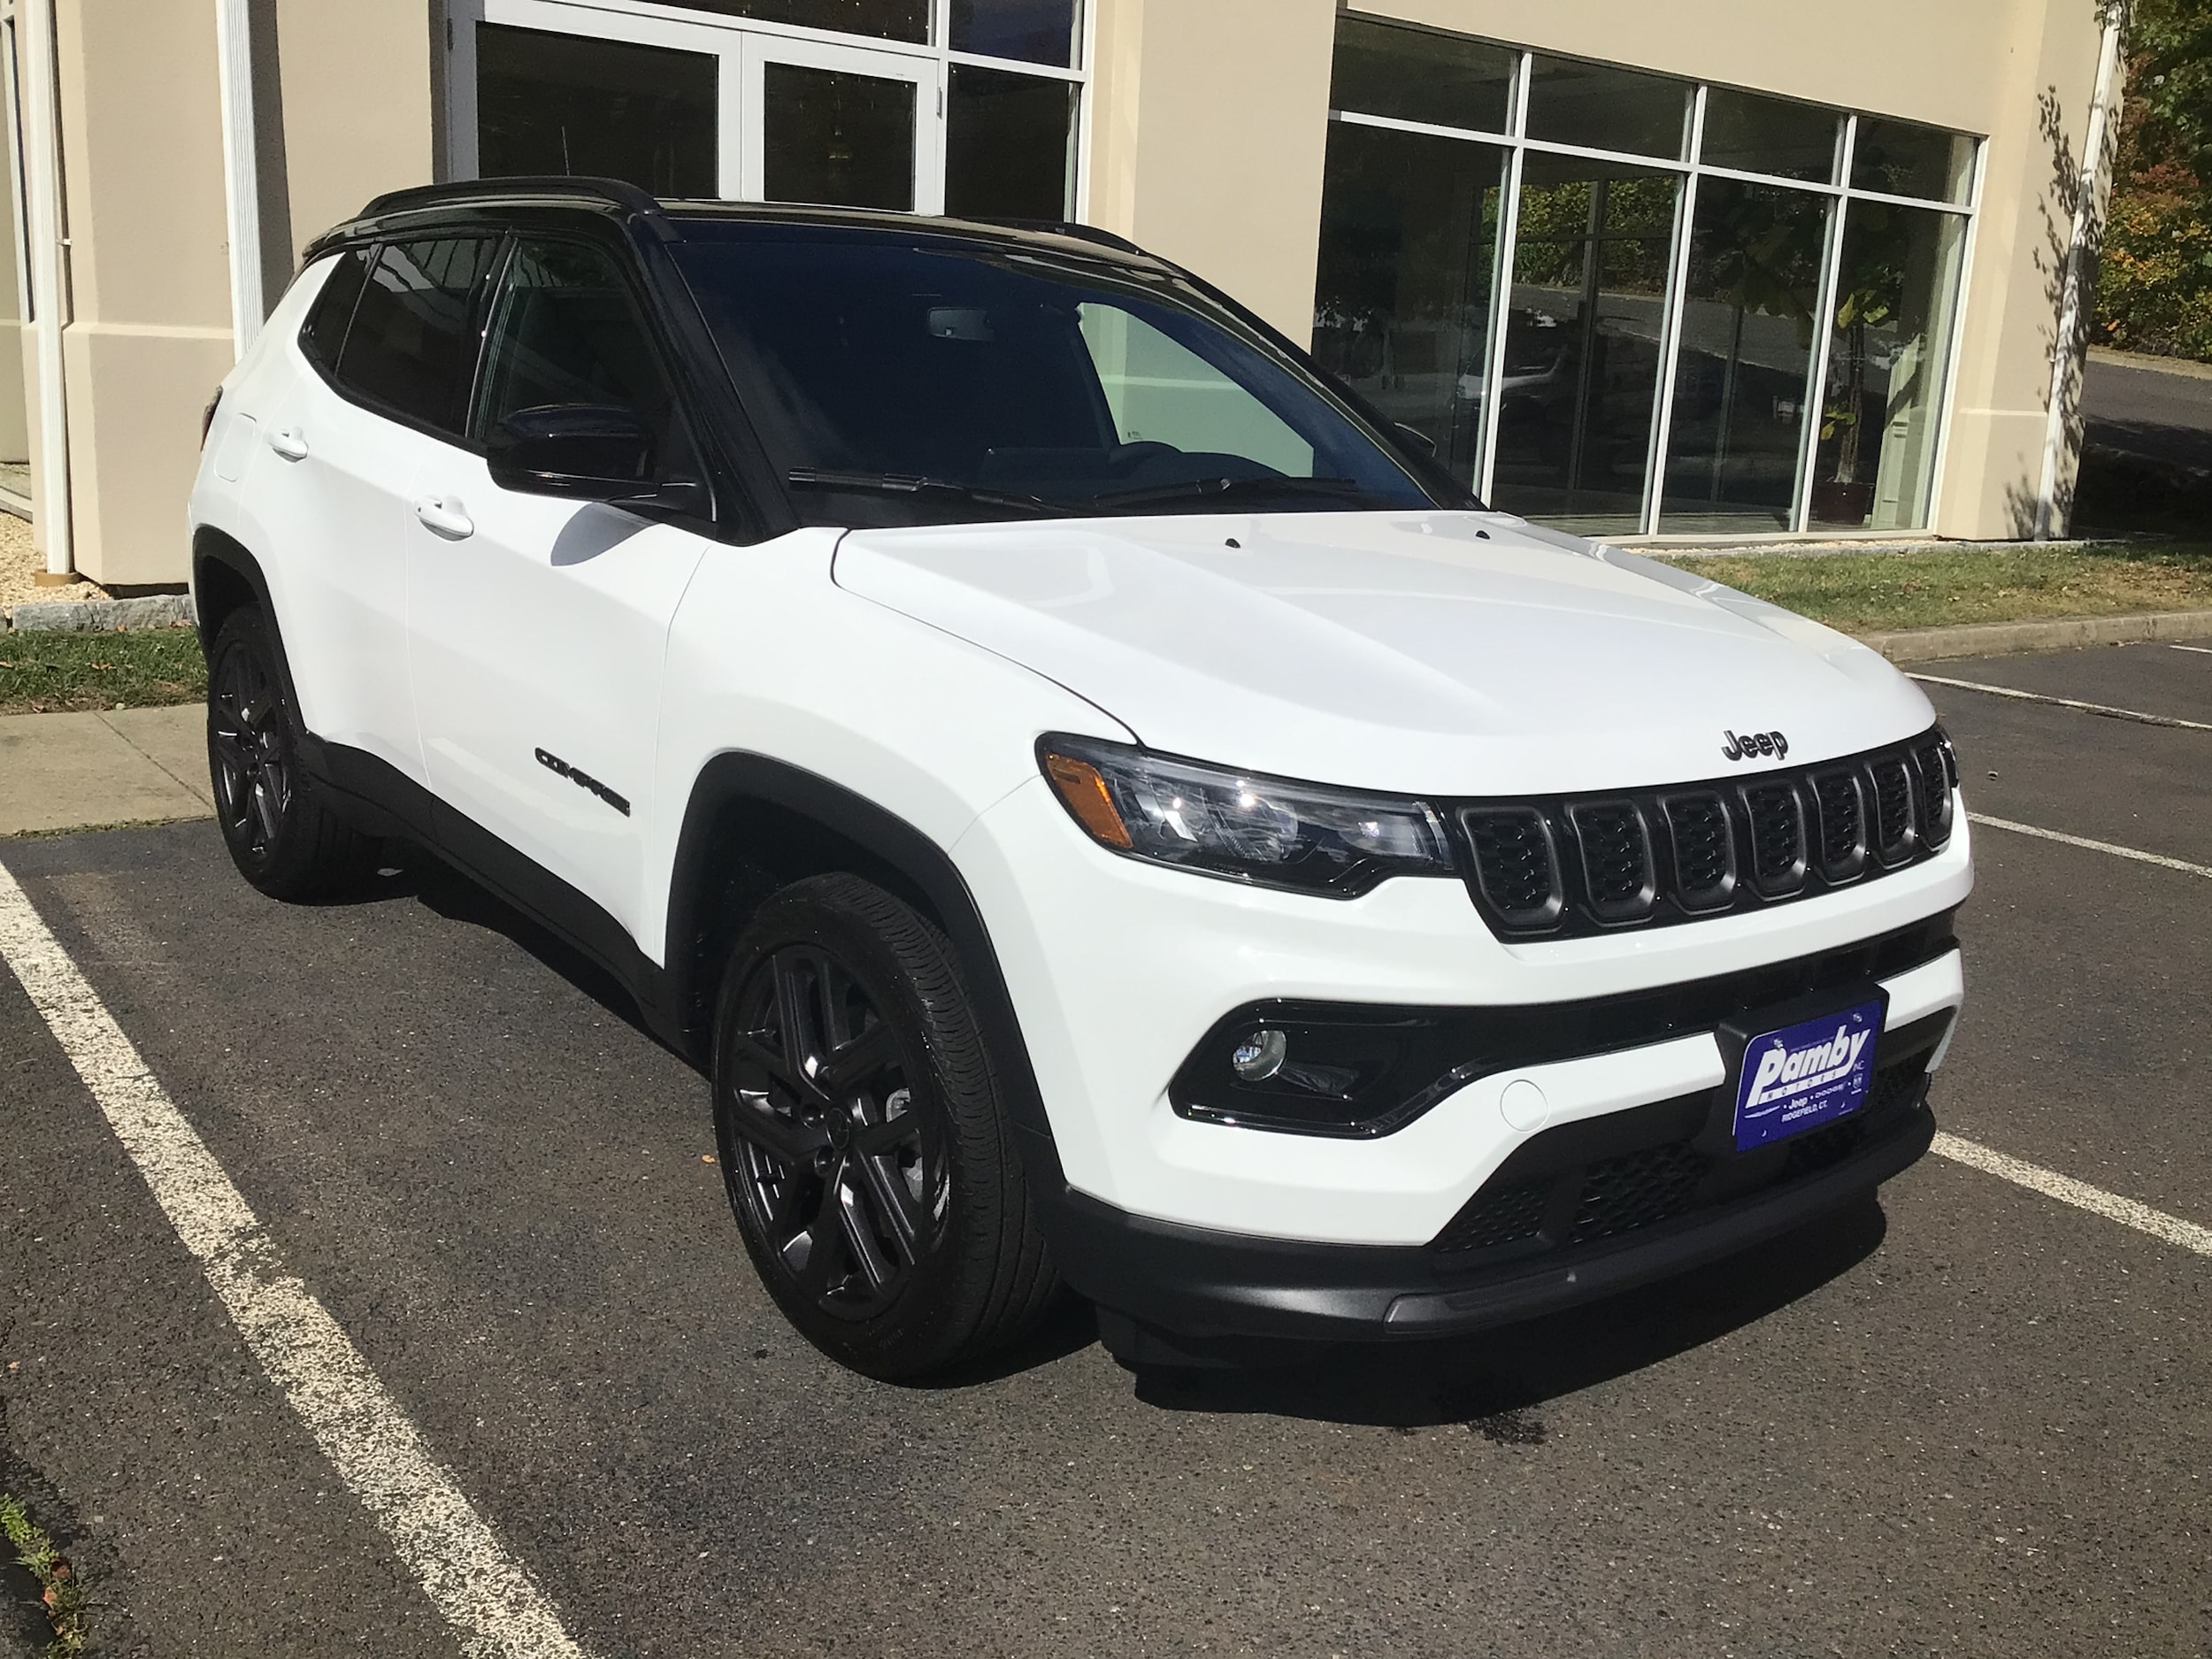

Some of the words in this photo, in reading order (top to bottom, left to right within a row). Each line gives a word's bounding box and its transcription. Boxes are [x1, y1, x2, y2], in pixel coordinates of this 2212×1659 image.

[1721, 730, 1789, 761] Jeep
[1745, 1025, 1871, 1109] Pamby
[1767, 1071, 1838, 1099] MOTORS
[1788, 1096, 1809, 1110] Jeep
